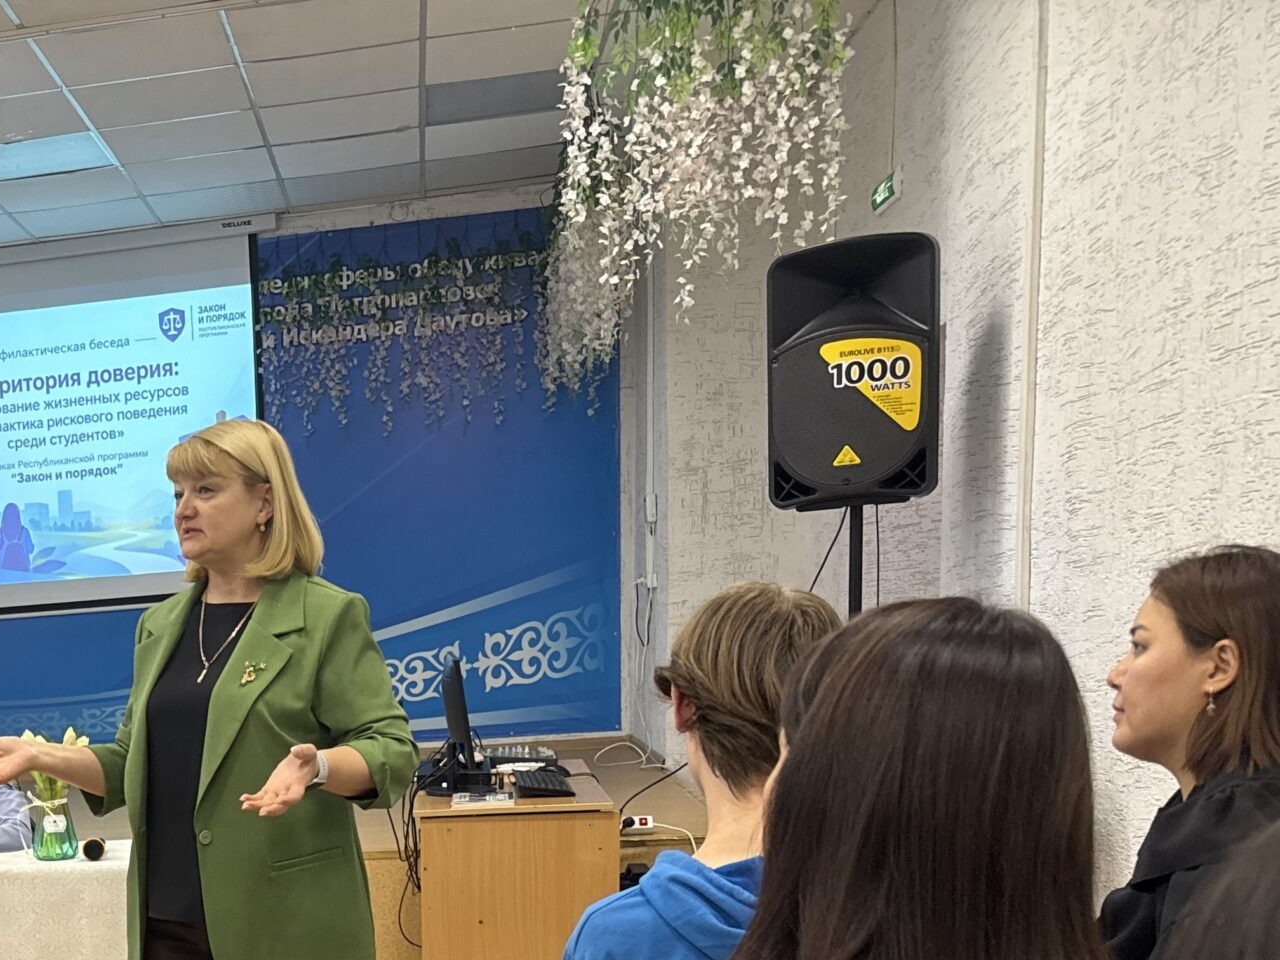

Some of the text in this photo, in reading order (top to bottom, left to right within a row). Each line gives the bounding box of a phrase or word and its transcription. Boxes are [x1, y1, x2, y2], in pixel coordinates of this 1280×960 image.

[198, 303, 227, 315] ЗАКОН
[198, 310, 247, 325] И ПОРЯДОК
[89, 337, 131, 351] беседа
[839, 347, 876, 358] EUROLIVE
[86, 359, 180, 388] доверия:
[829, 356, 910, 387] 1000
[870, 381, 912, 392] WATTS
[43, 391, 121, 411] жизненных
[124, 384, 190, 408] ресурсов
[47, 410, 114, 431] рискового
[116, 403, 189, 422] поведения
[7, 428, 126, 453] среди студентов»
[17, 453, 96, 472] Республиканской
[96, 449, 149, 465] программы
[55, 470, 63, 480] и
